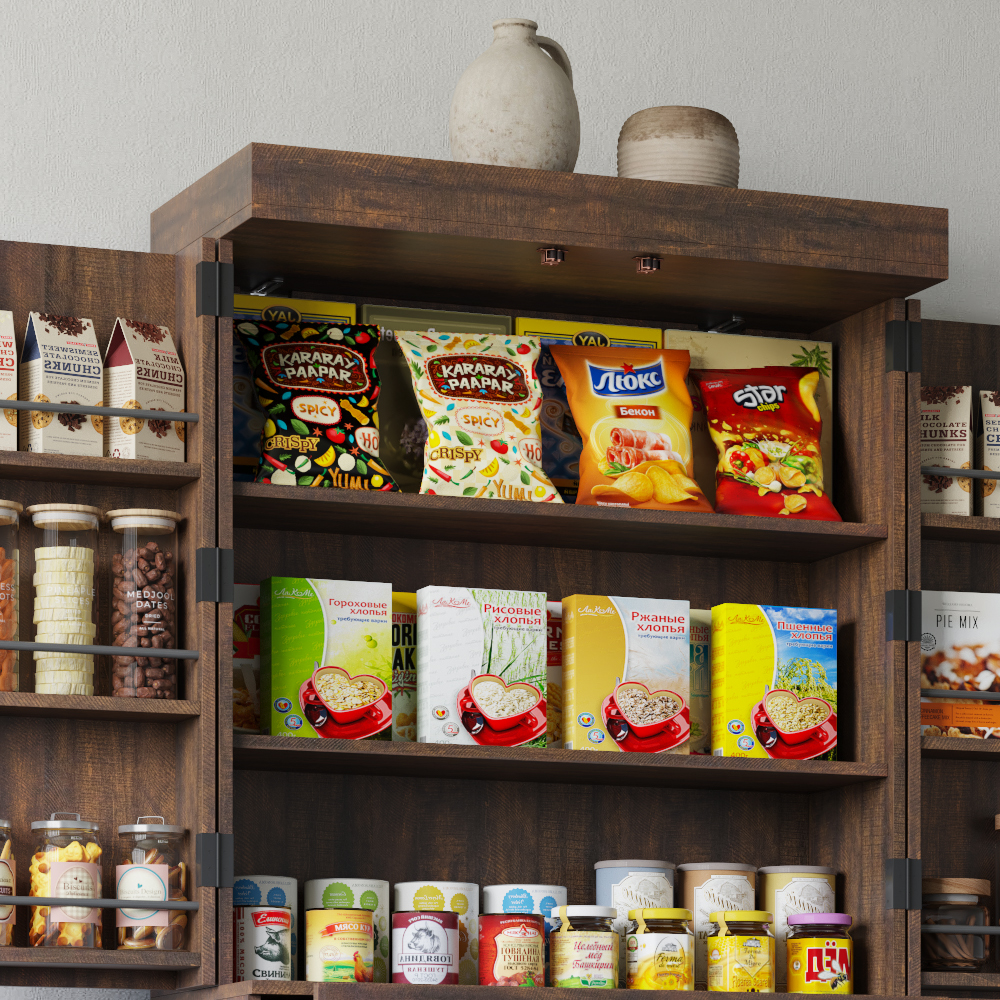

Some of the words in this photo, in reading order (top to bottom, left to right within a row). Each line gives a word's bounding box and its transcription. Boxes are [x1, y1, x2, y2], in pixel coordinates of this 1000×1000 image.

[278, 351, 355, 369] KARARAY
[285, 366, 352, 384] PAAPAR
[442, 362, 517, 381] KARARAY
[448, 377, 514, 395] PAAPAR
[299, 403, 337, 417] SPICY
[619, 406, 656, 417] Бекон
[757, 402, 780, 412] chips
[462, 414, 500, 428] SPICY
[920, 430, 967, 438] HUNKS
[265, 435, 321, 453] CRISPY
[430, 446, 483, 463] CRISPY
[127, 590, 174, 600] MEDJOOL
[55, 597, 89, 605] SLICES
[136, 601, 168, 609] DATES
[329, 598, 387, 609] Гороховые
[350, 608, 387, 616] хлопья
[484, 604, 542, 616] Рисовые
[494, 616, 541, 625] хлопья
[631, 612, 685, 624] Ржаные
[936, 615, 953, 628] PIE
[959, 616, 978, 629] MIX
[637, 624, 685, 634] хлопья
[777, 621, 833, 633] Пшенные
[791, 632, 833, 641] хлопья
[63, 882, 93, 891] Biscuits
